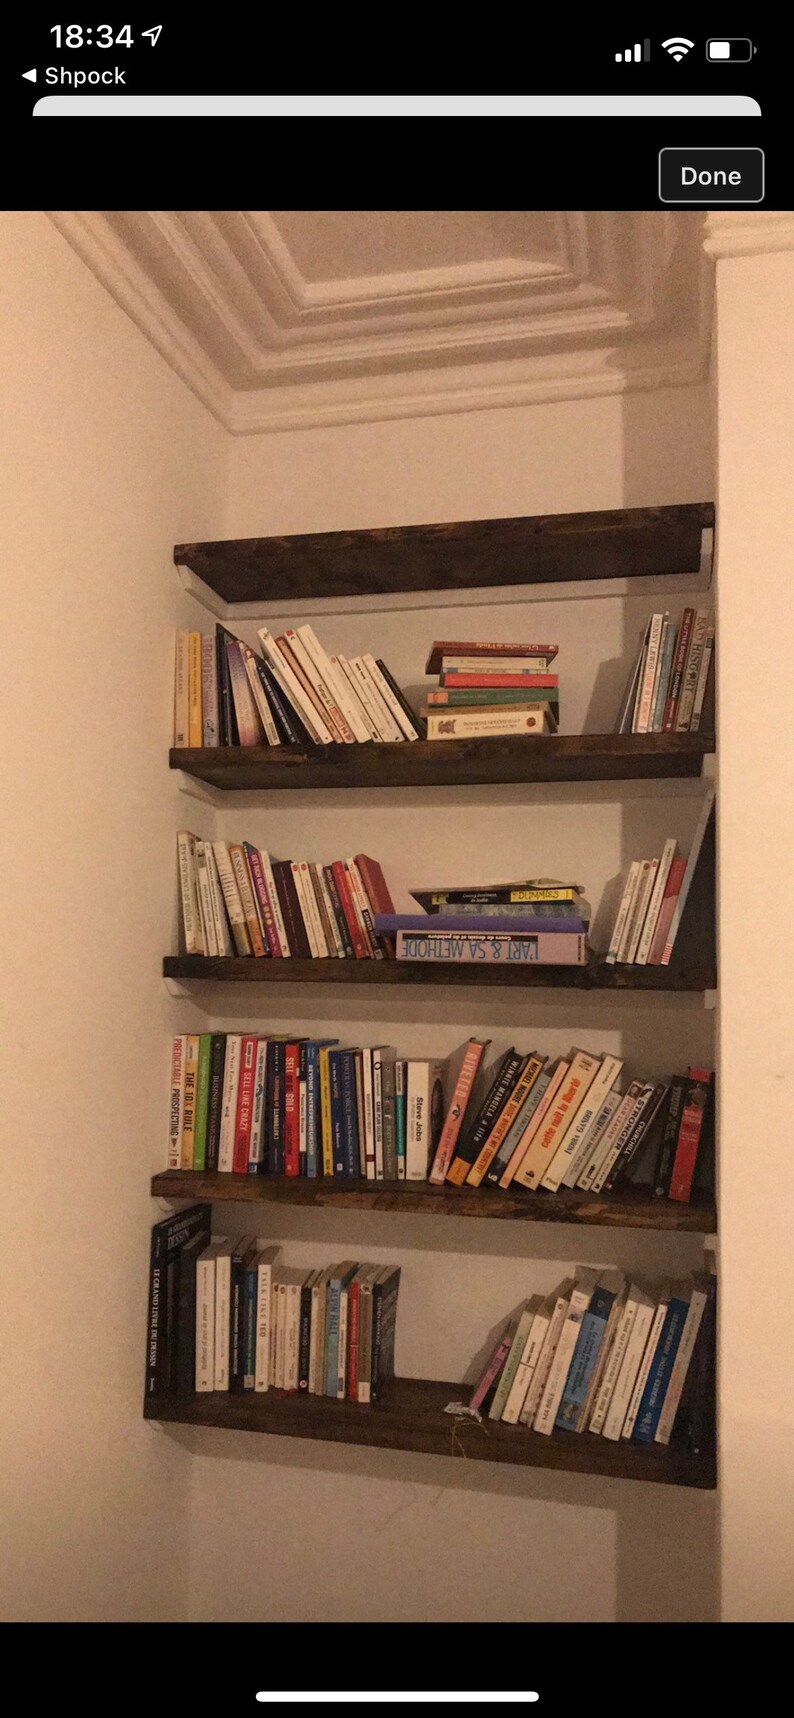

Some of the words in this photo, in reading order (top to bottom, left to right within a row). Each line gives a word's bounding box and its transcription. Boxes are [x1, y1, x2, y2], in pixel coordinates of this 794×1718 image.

[671, 671, 680, 698] LONDON
[518, 890, 560, 899] DUMMIES
[467, 940, 486, 959] SA
[490, 941, 502, 960] &
[506, 941, 538, 960] L'ART
[172, 1038, 182, 1085] PREDICTABLE
[285, 1056, 293, 1073] SELL
[184, 1072, 194, 1087] THE
[243, 1071, 251, 1088] SELL
[501, 1059, 519, 1086] WINNIE
[521, 1060, 538, 1084] MICHAEL
[184, 1092, 193, 1106] 10X
[241, 1090, 250, 1105] LIKE
[285, 1093, 294, 1112] SOLD
[485, 1085, 506, 1118] MANDELA
[511, 1083, 527, 1103] MOORE
[170, 1089, 180, 1136] PROSPECTING
[415, 1096, 423, 1119] Steve
[183, 1109, 192, 1132] RULE
[239, 1107, 248, 1131] CRAZY
[549, 1110, 564, 1128] nuit
[613, 1098, 645, 1151] STRONGER
[623, 1119, 646, 1156] CHURCHILL
[153, 1268, 160, 1277] LE
[328, 1287, 338, 1312] ALVIN
[150, 1328, 157, 1340] DU
[328, 1314, 337, 1336] HALL
